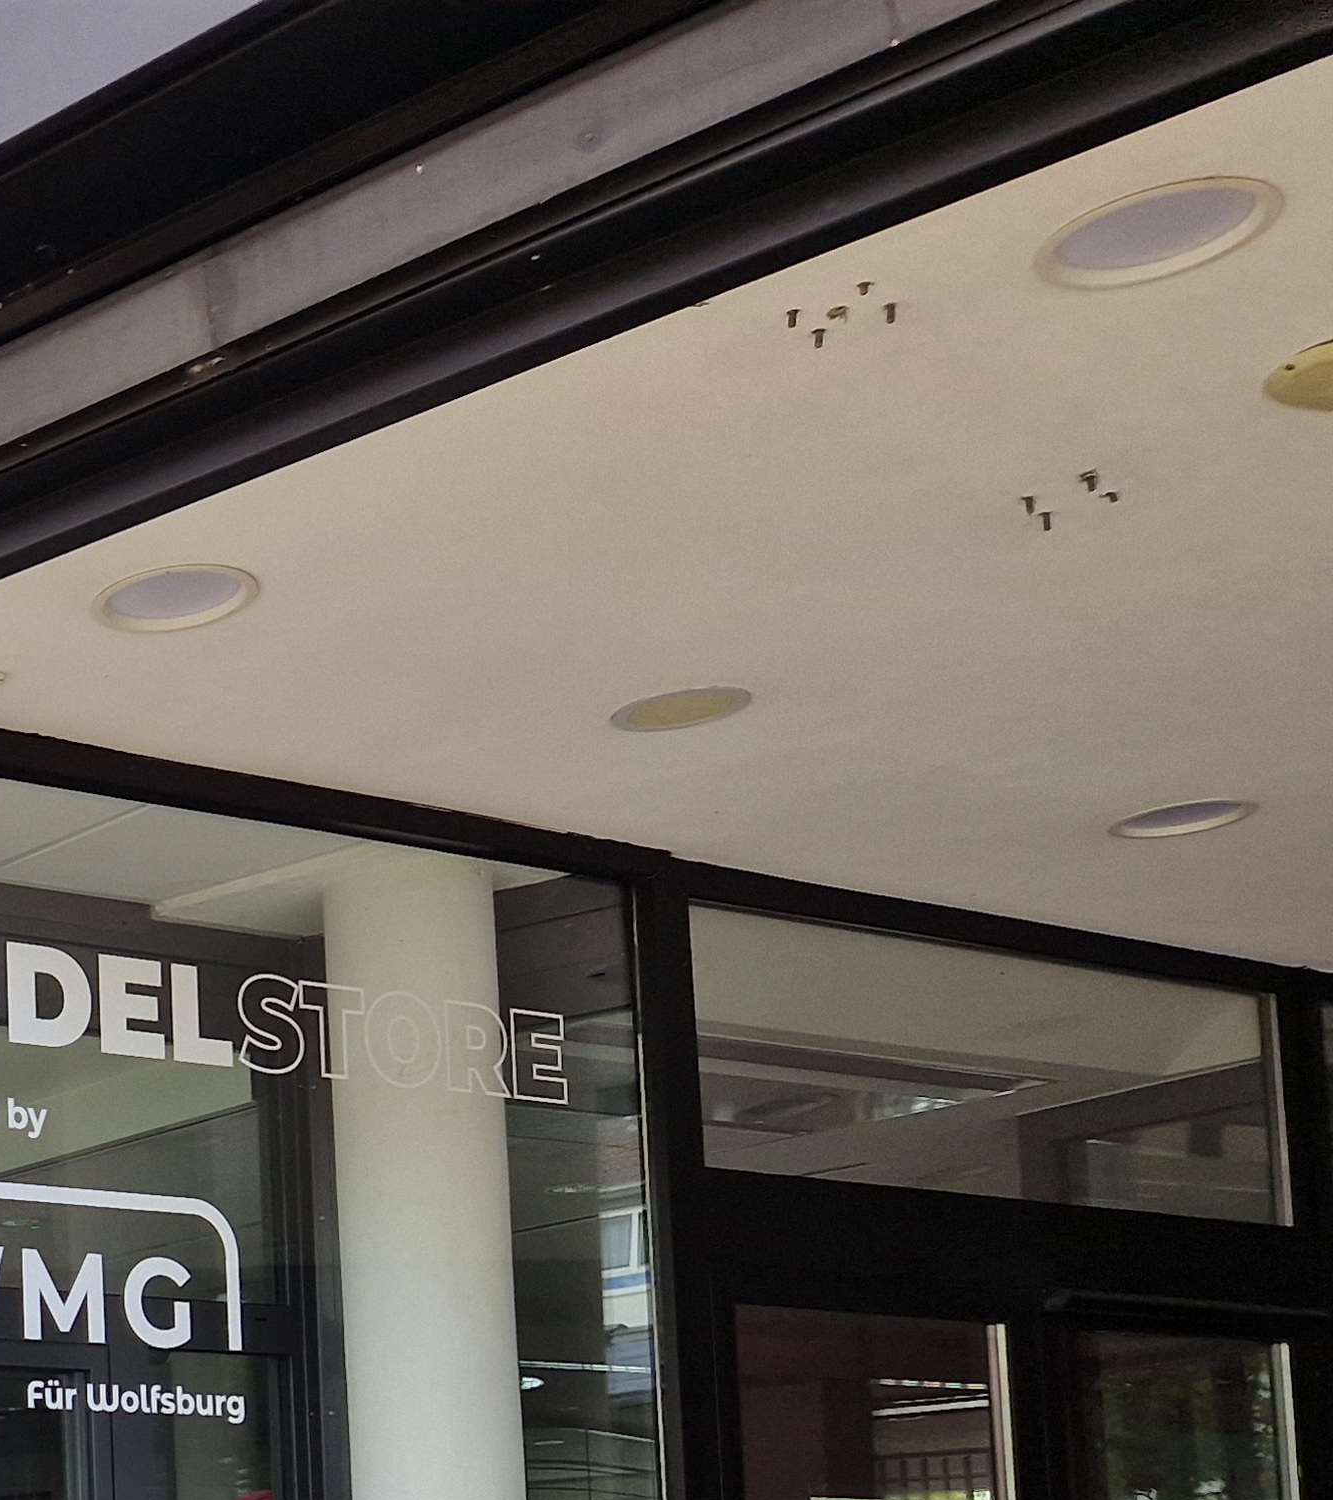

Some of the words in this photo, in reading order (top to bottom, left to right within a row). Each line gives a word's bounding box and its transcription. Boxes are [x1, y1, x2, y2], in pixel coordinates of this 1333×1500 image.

[7, 1097, 48, 1140] by
[27, 1380, 77, 1413] Für
[86, 1383, 246, 1426] Wolfsburg
